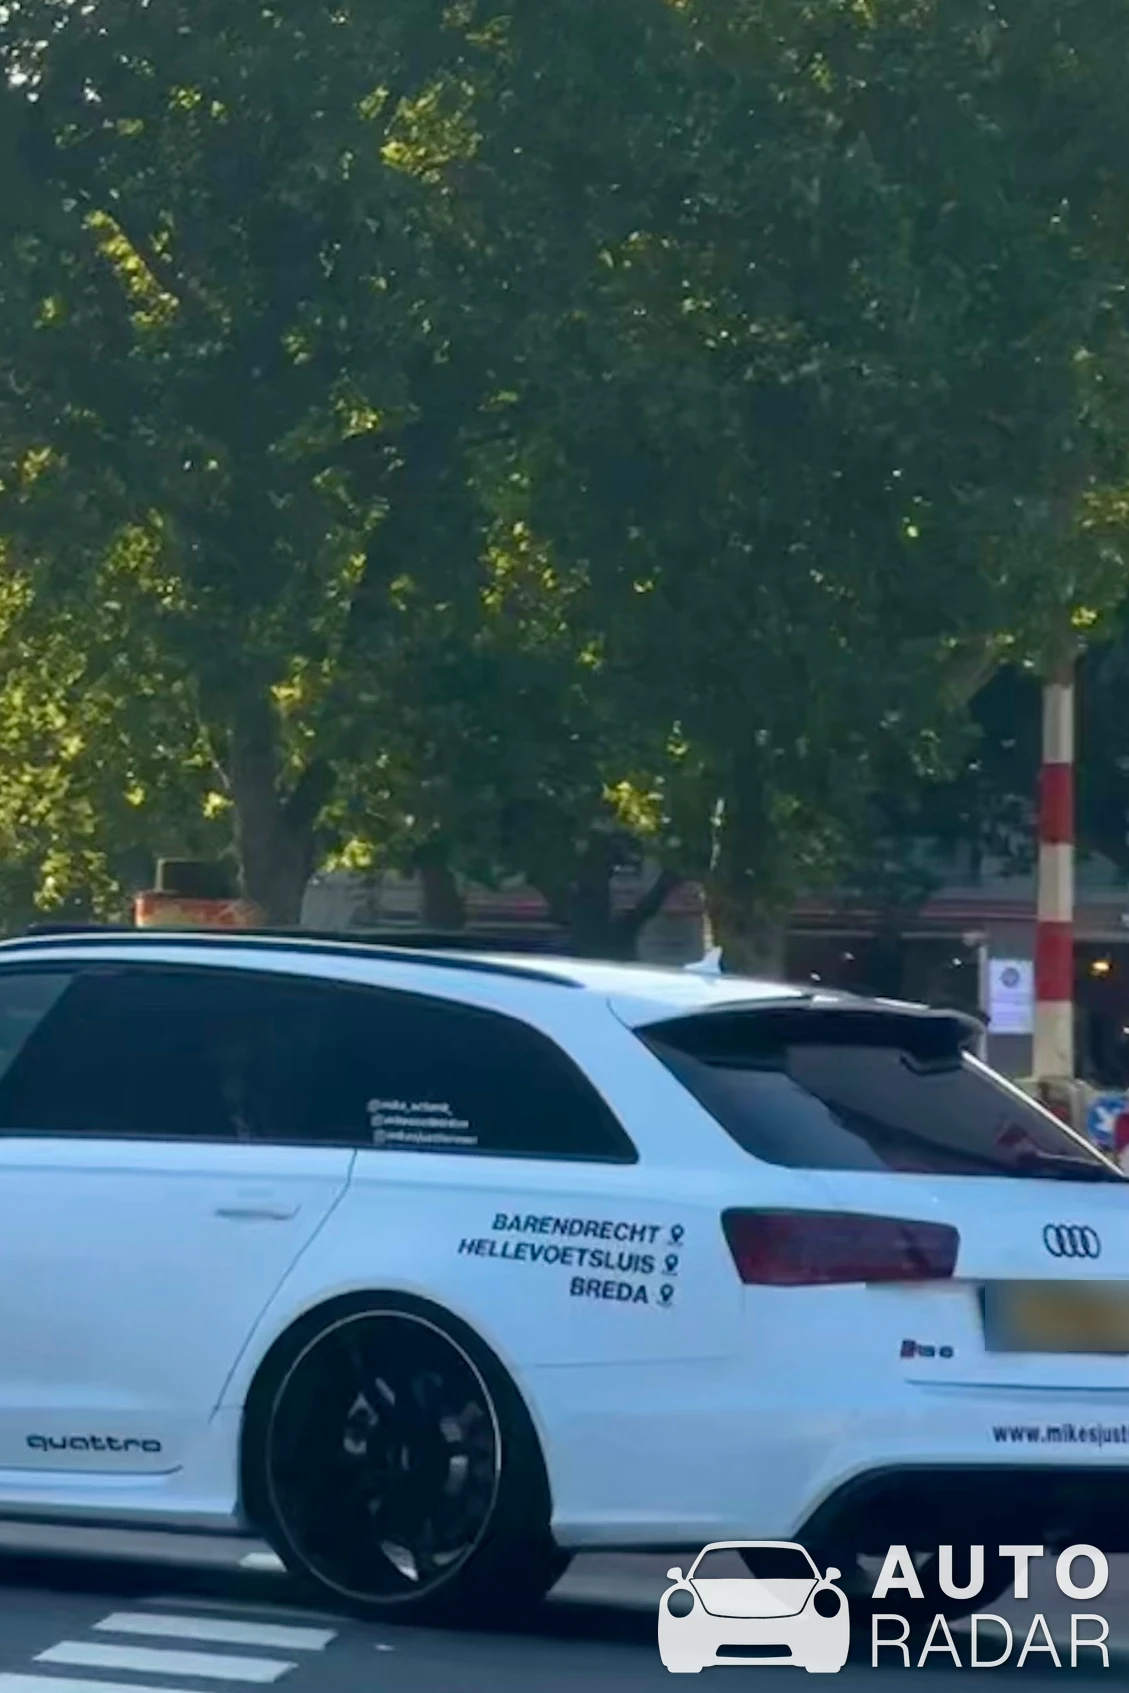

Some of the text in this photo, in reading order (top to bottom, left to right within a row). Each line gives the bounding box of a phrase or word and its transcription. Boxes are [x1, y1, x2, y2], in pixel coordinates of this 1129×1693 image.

[492, 1212, 661, 1244] BARENDRECHT
[457, 1238, 656, 1275] HELLEVOETSLUIS
[569, 1276, 649, 1304] BREDA
[26, 1434, 162, 1452] quattro
